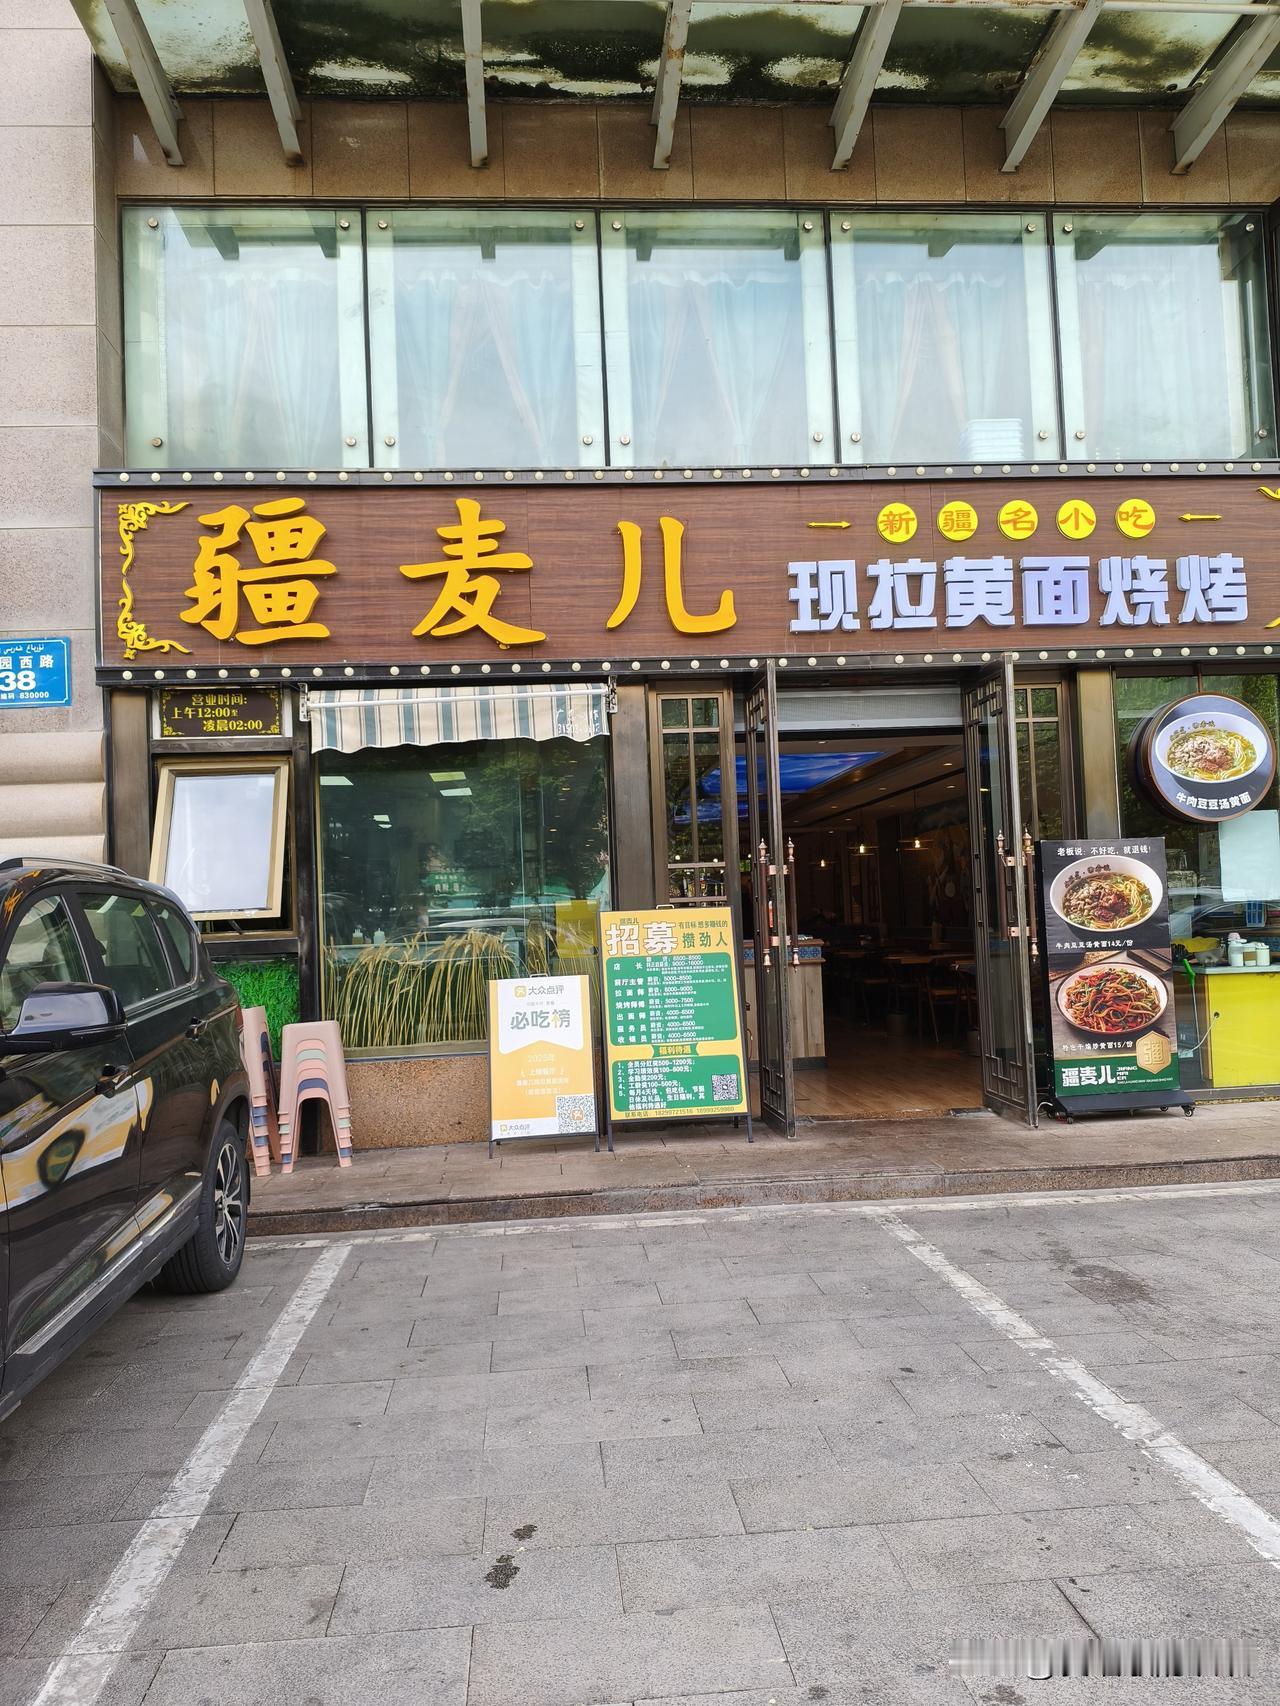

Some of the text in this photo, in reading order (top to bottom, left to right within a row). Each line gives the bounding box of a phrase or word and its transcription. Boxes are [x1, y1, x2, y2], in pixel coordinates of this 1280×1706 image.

[878, 501, 1155, 541] 新疆名小吃
[180, 497, 736, 648] 疆麦儿
[788, 552, 1249, 633] 现拉黄面烧烤
[0, 654, 54, 669] 园西路
[19, 691, 50, 699] 830000
[192, 694, 248, 706] 营业时间:
[203, 719, 263, 732] 凌晨02:00
[1175, 791, 1252, 810] 牛肉豆豆汤黄面
[605, 920, 679, 956] 招募
[528, 984, 565, 996] 大众点评
[1061, 1064, 1116, 1087] 疆麦儿
